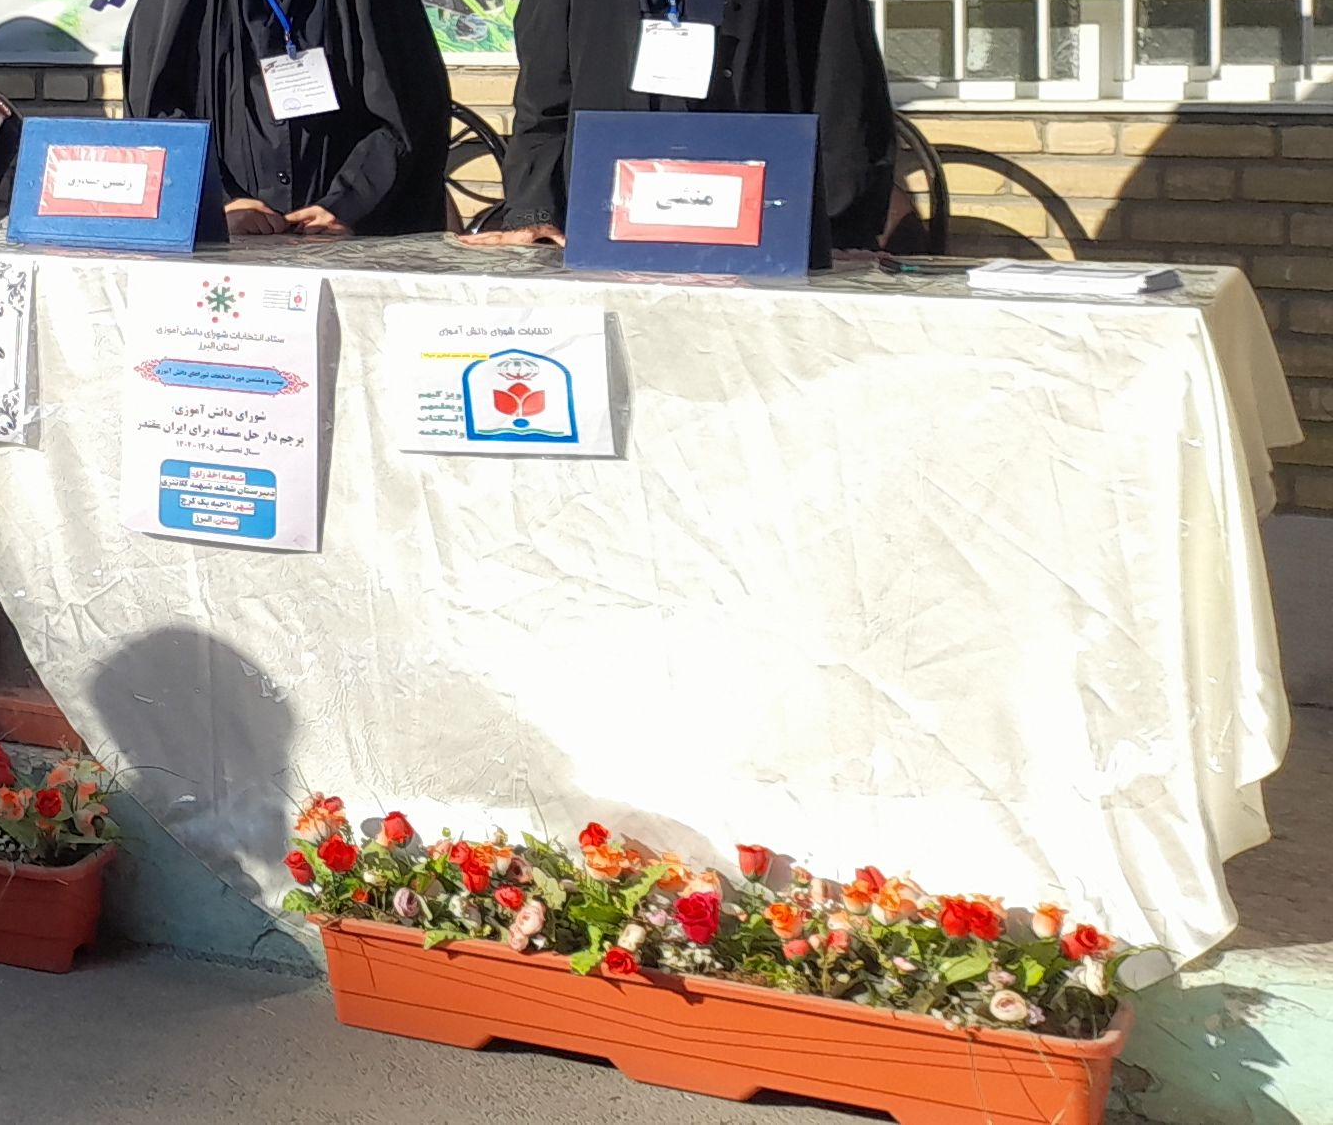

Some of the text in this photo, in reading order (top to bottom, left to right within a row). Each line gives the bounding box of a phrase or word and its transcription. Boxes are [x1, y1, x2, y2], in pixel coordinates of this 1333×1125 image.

[656, 188, 714, 211] منشی
[438, 324, 463, 337] آموزی
[466, 326, 488, 337] دانش
[517, 326, 553, 336] انتخابات
[216, 342, 240, 352] استان
[207, 407, 233, 419] دانش
[235, 410, 267, 424] شورای
[162, 422, 187, 435] ایران
[188, 424, 210, 438] برای
[243, 429, 260, 442] حل
[263, 430, 278, 444] دار
[279, 434, 305, 448] پرچم
